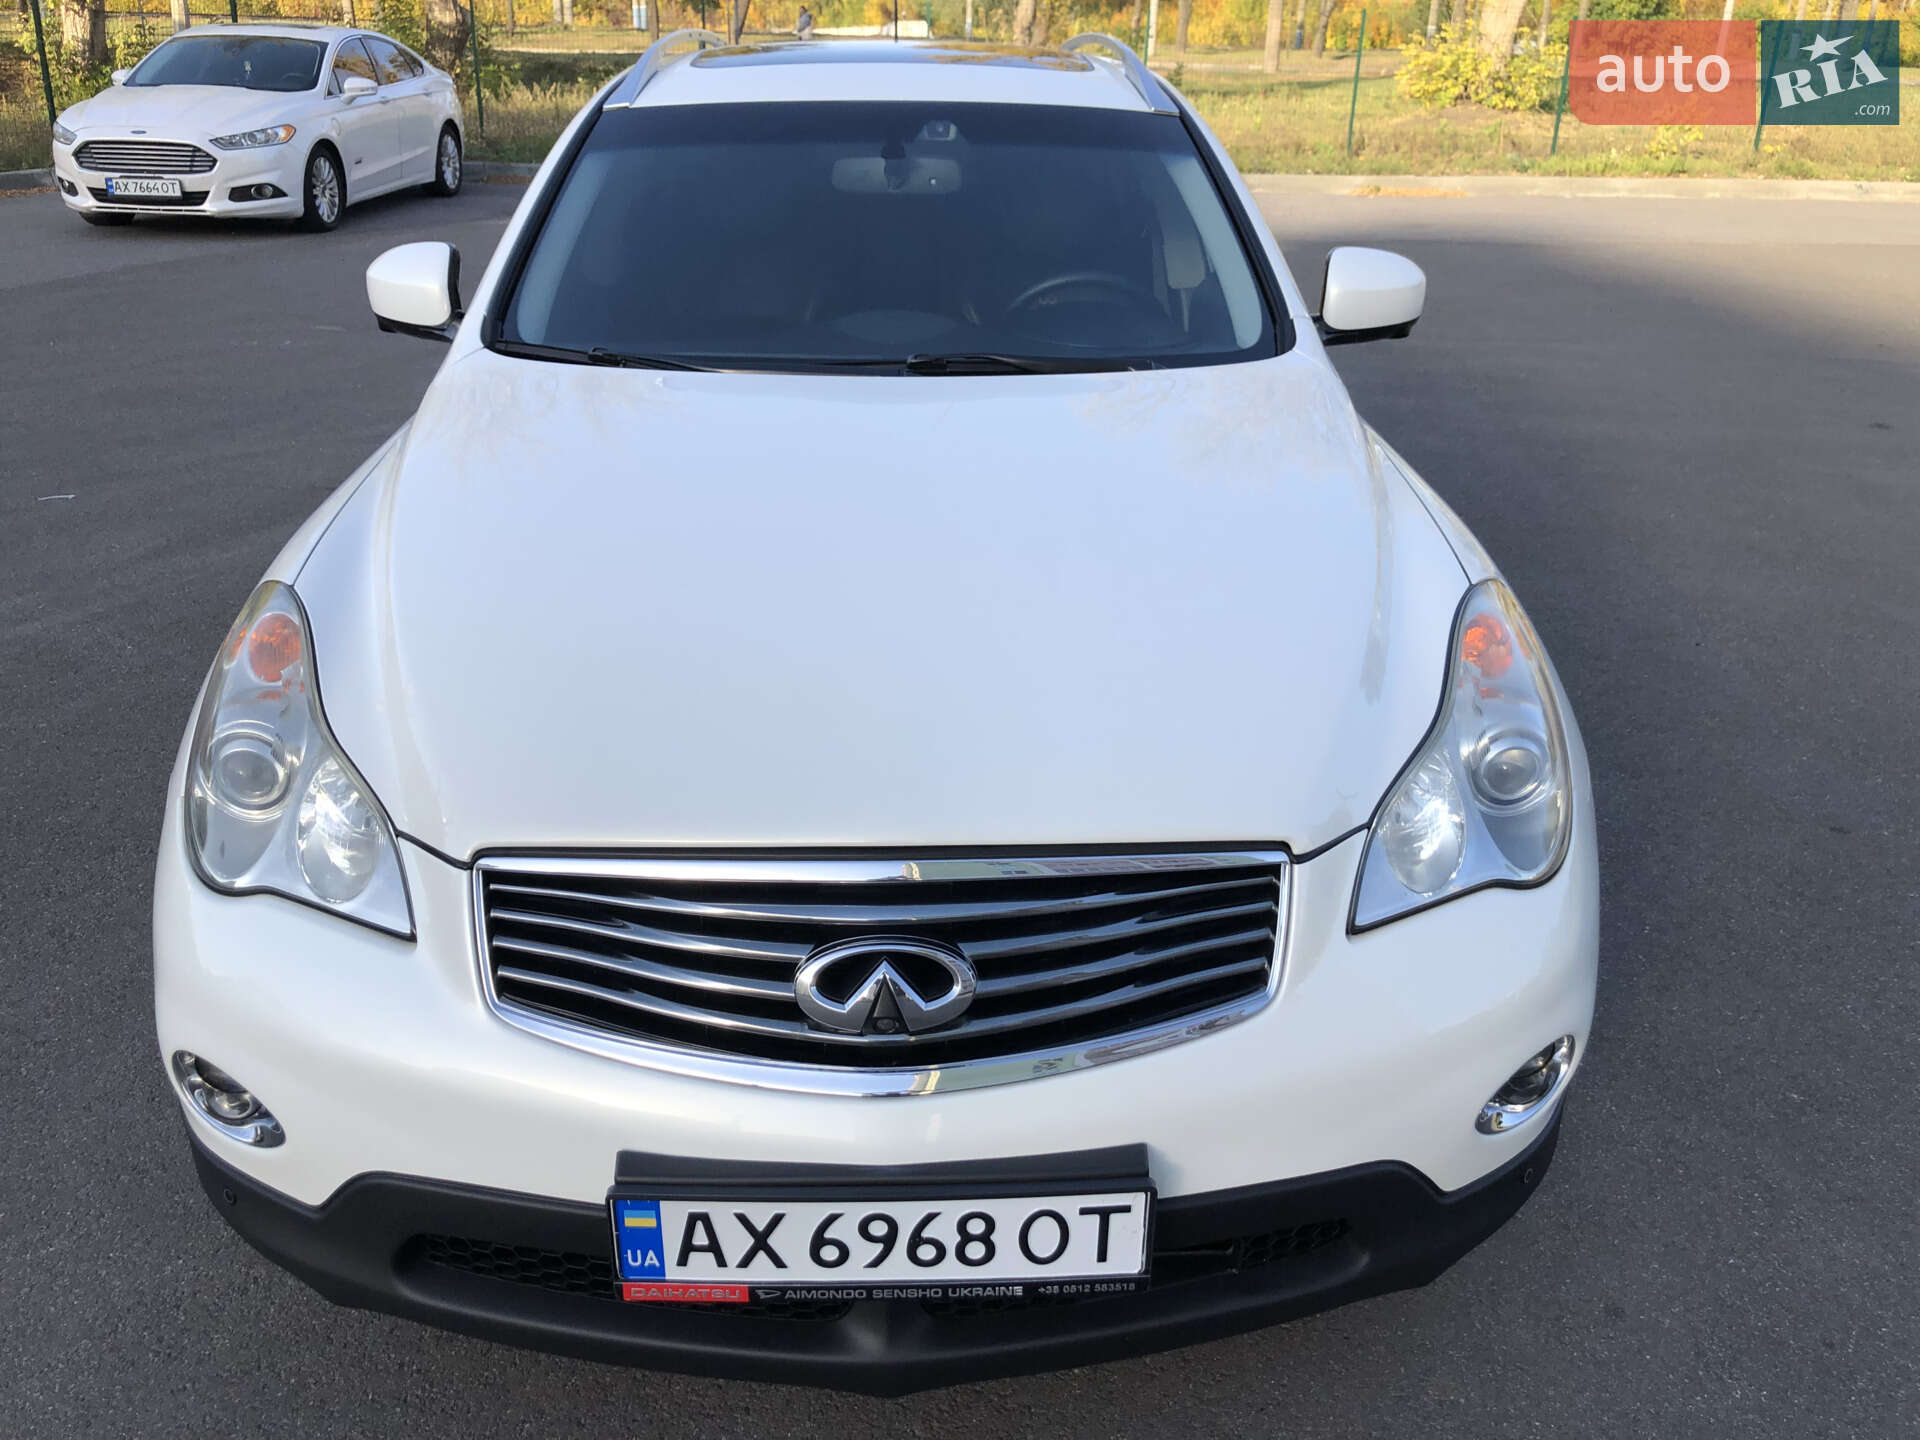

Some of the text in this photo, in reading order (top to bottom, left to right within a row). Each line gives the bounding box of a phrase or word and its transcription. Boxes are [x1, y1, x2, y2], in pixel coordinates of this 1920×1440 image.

[114, 181, 131, 193] AX
[131, 181, 160, 193] 7664
[161, 182, 177, 194] OT
[675, 1204, 1133, 1270] AX 6968 OT
[627, 1249, 660, 1267] UA
[630, 1287, 741, 1299] DAIHATSU
[872, 1288, 942, 1299] SENSHO
[949, 1286, 1024, 1297] UKRAINE
